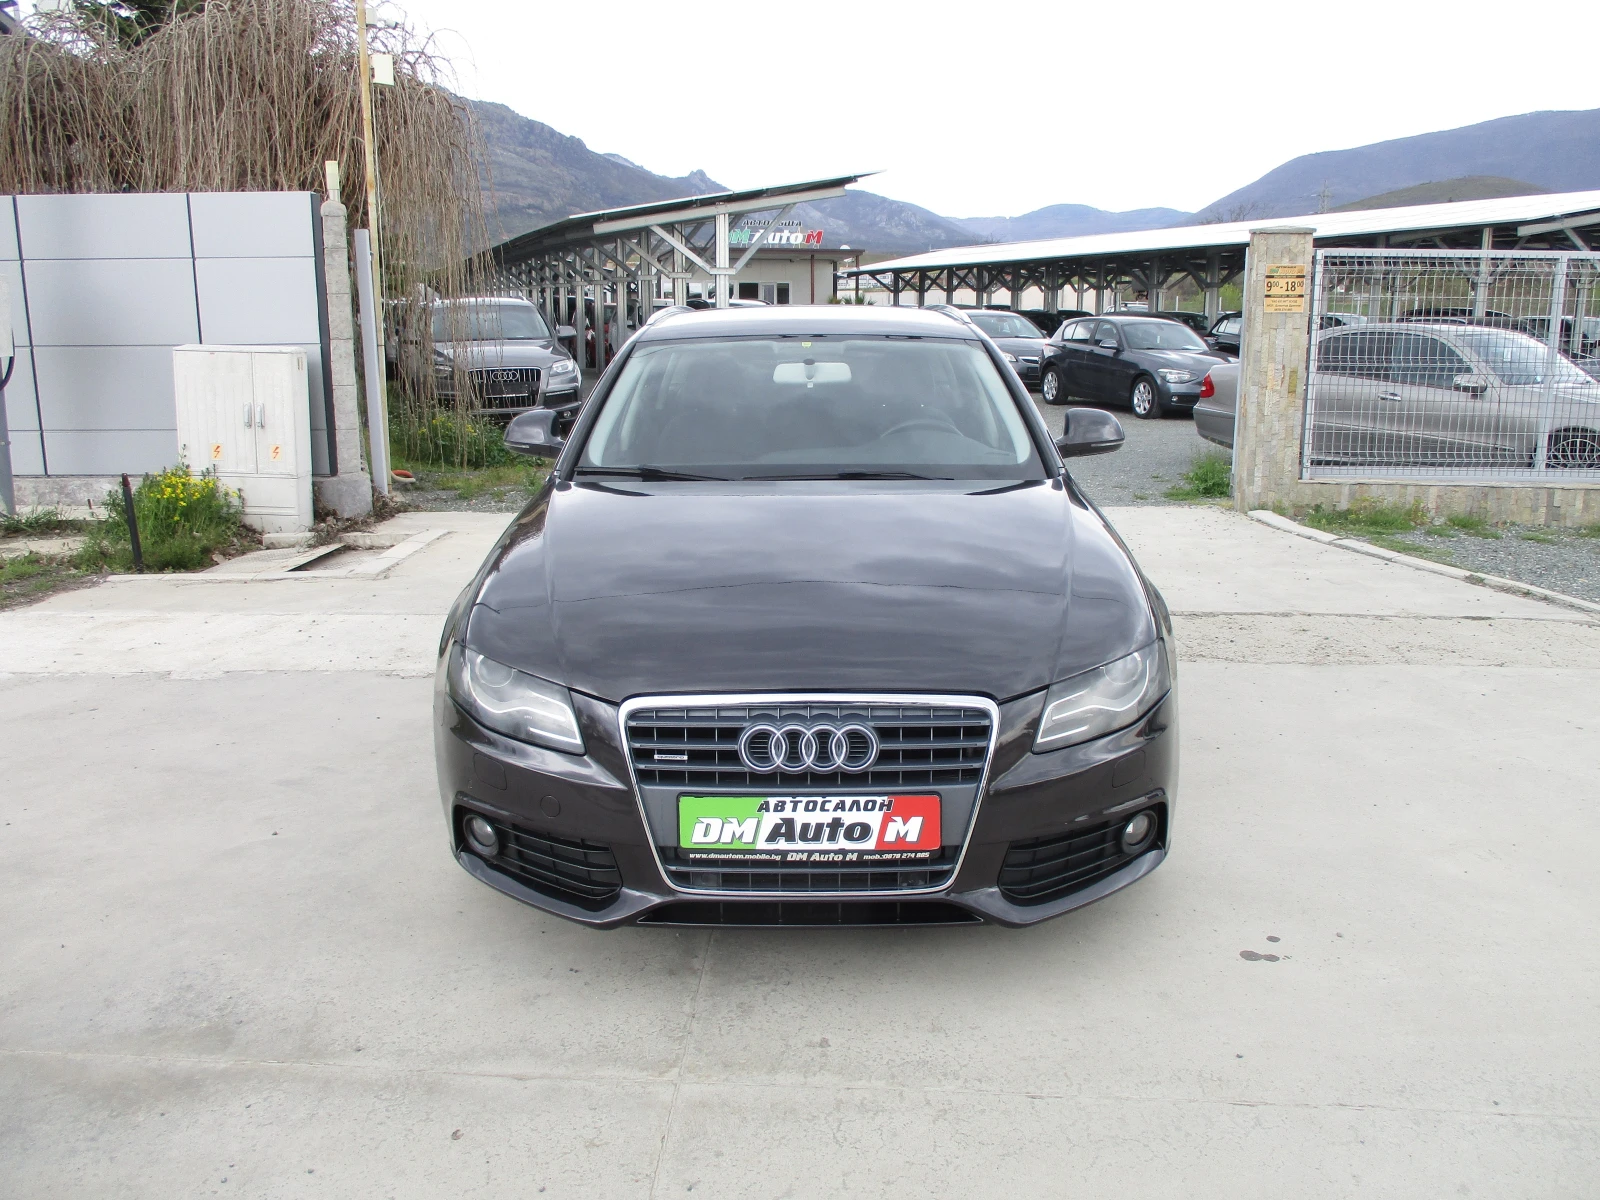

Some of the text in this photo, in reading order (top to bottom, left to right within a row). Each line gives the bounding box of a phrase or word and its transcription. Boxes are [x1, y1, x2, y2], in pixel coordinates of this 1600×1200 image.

[805, 229, 824, 244] M
[757, 799, 894, 813] АВТОСАЛОН
[691, 816, 924, 844] DM Auto M
[689, 852, 782, 861] www.dmautom.mobile.bg
[786, 852, 808, 861] DM
[810, 852, 843, 861] Auto
[845, 852, 858, 861] M
